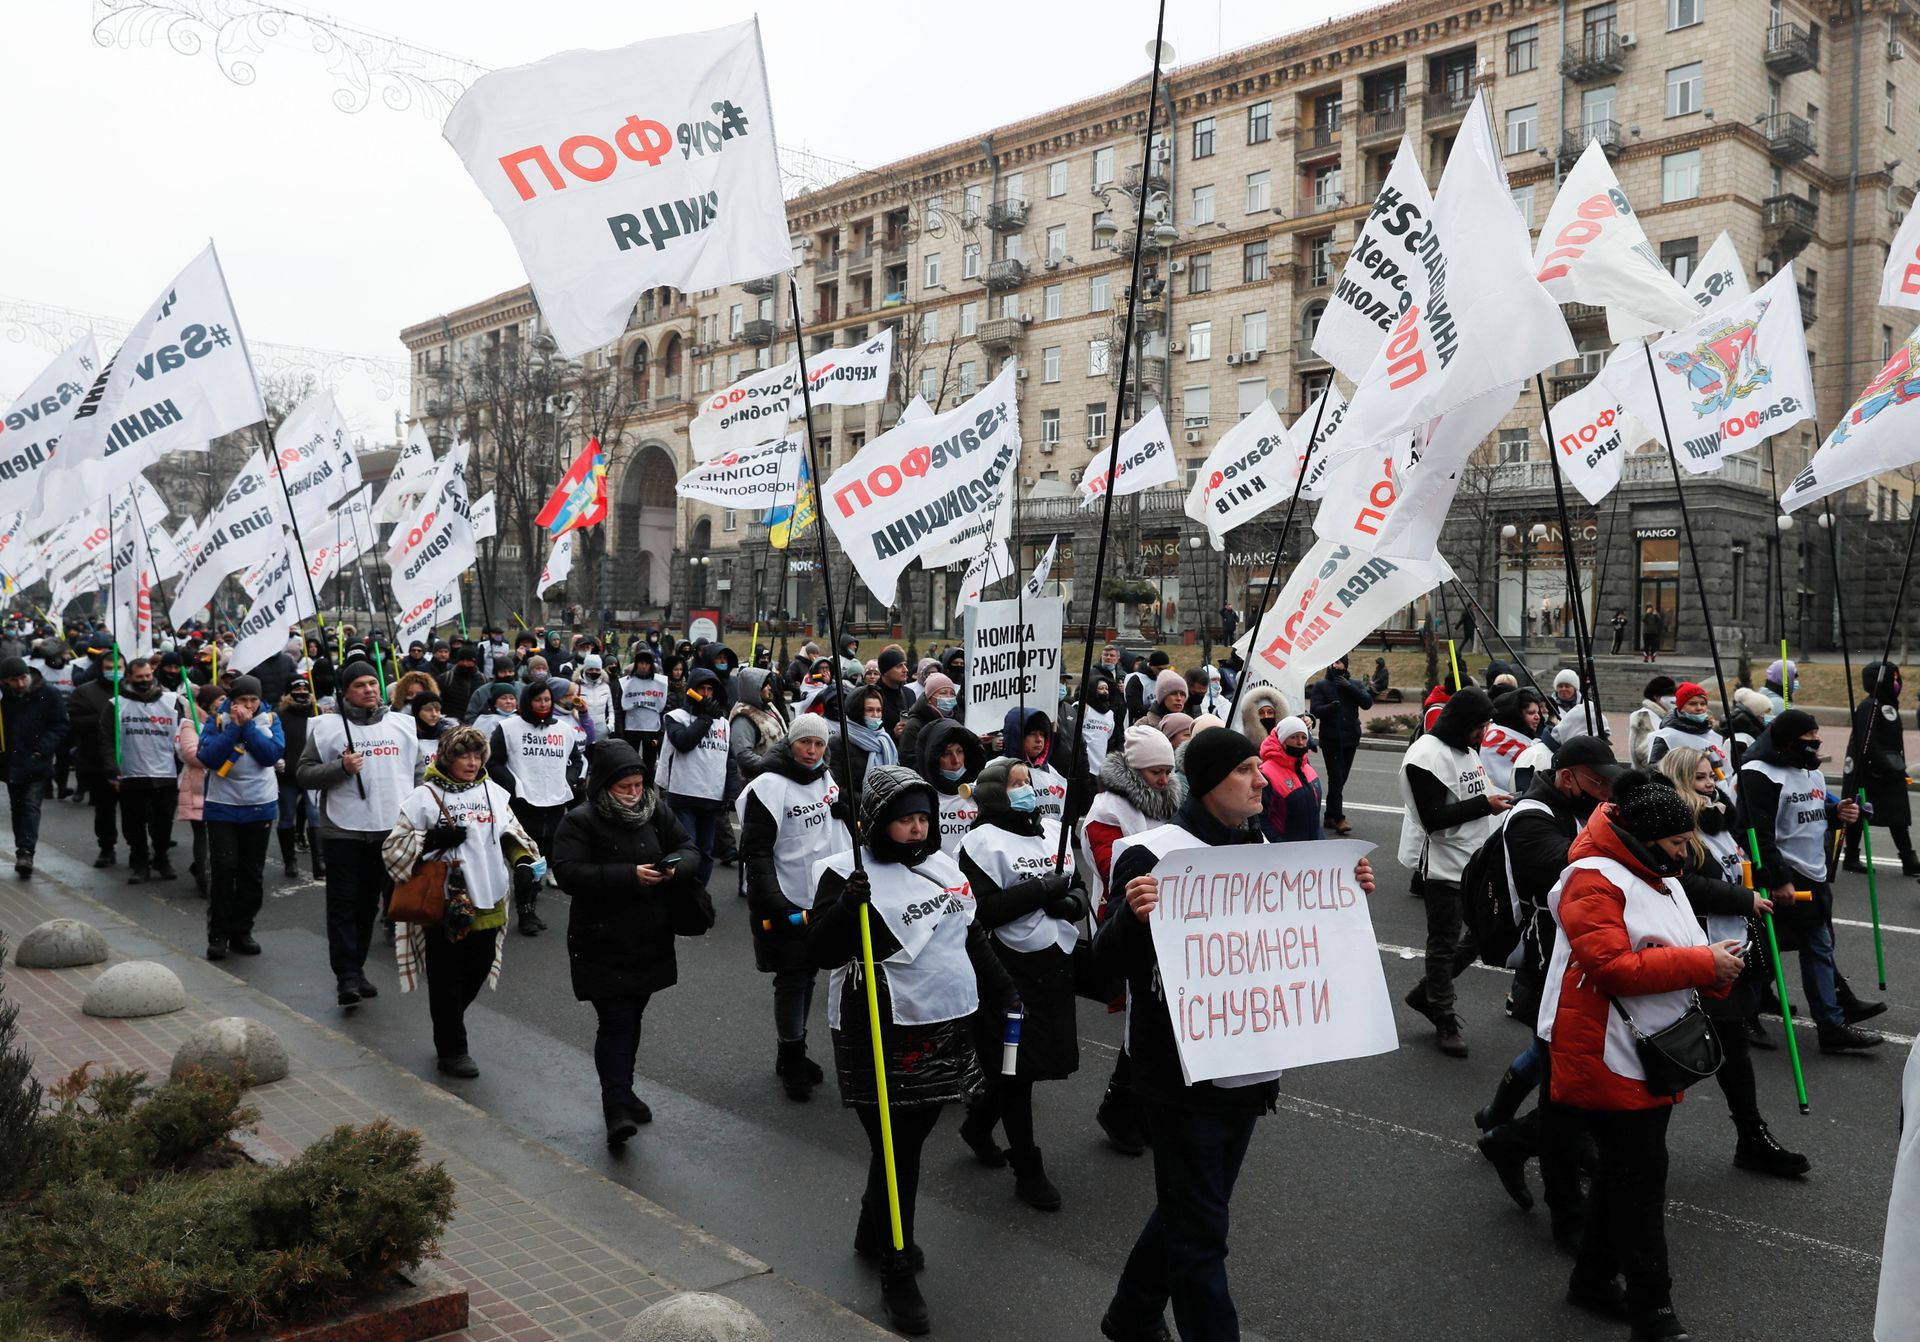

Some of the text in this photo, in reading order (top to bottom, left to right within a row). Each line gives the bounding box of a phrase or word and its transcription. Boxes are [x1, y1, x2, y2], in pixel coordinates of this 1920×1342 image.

[1351, 234, 1408, 292] Херс
[1637, 529, 1677, 538] MANGO
[973, 675, 1037, 704] ПРАЦЮЄ!
[522, 732, 564, 746] #SaveФОП
[523, 747, 564, 758] ЗАГАЛЬЦІ
